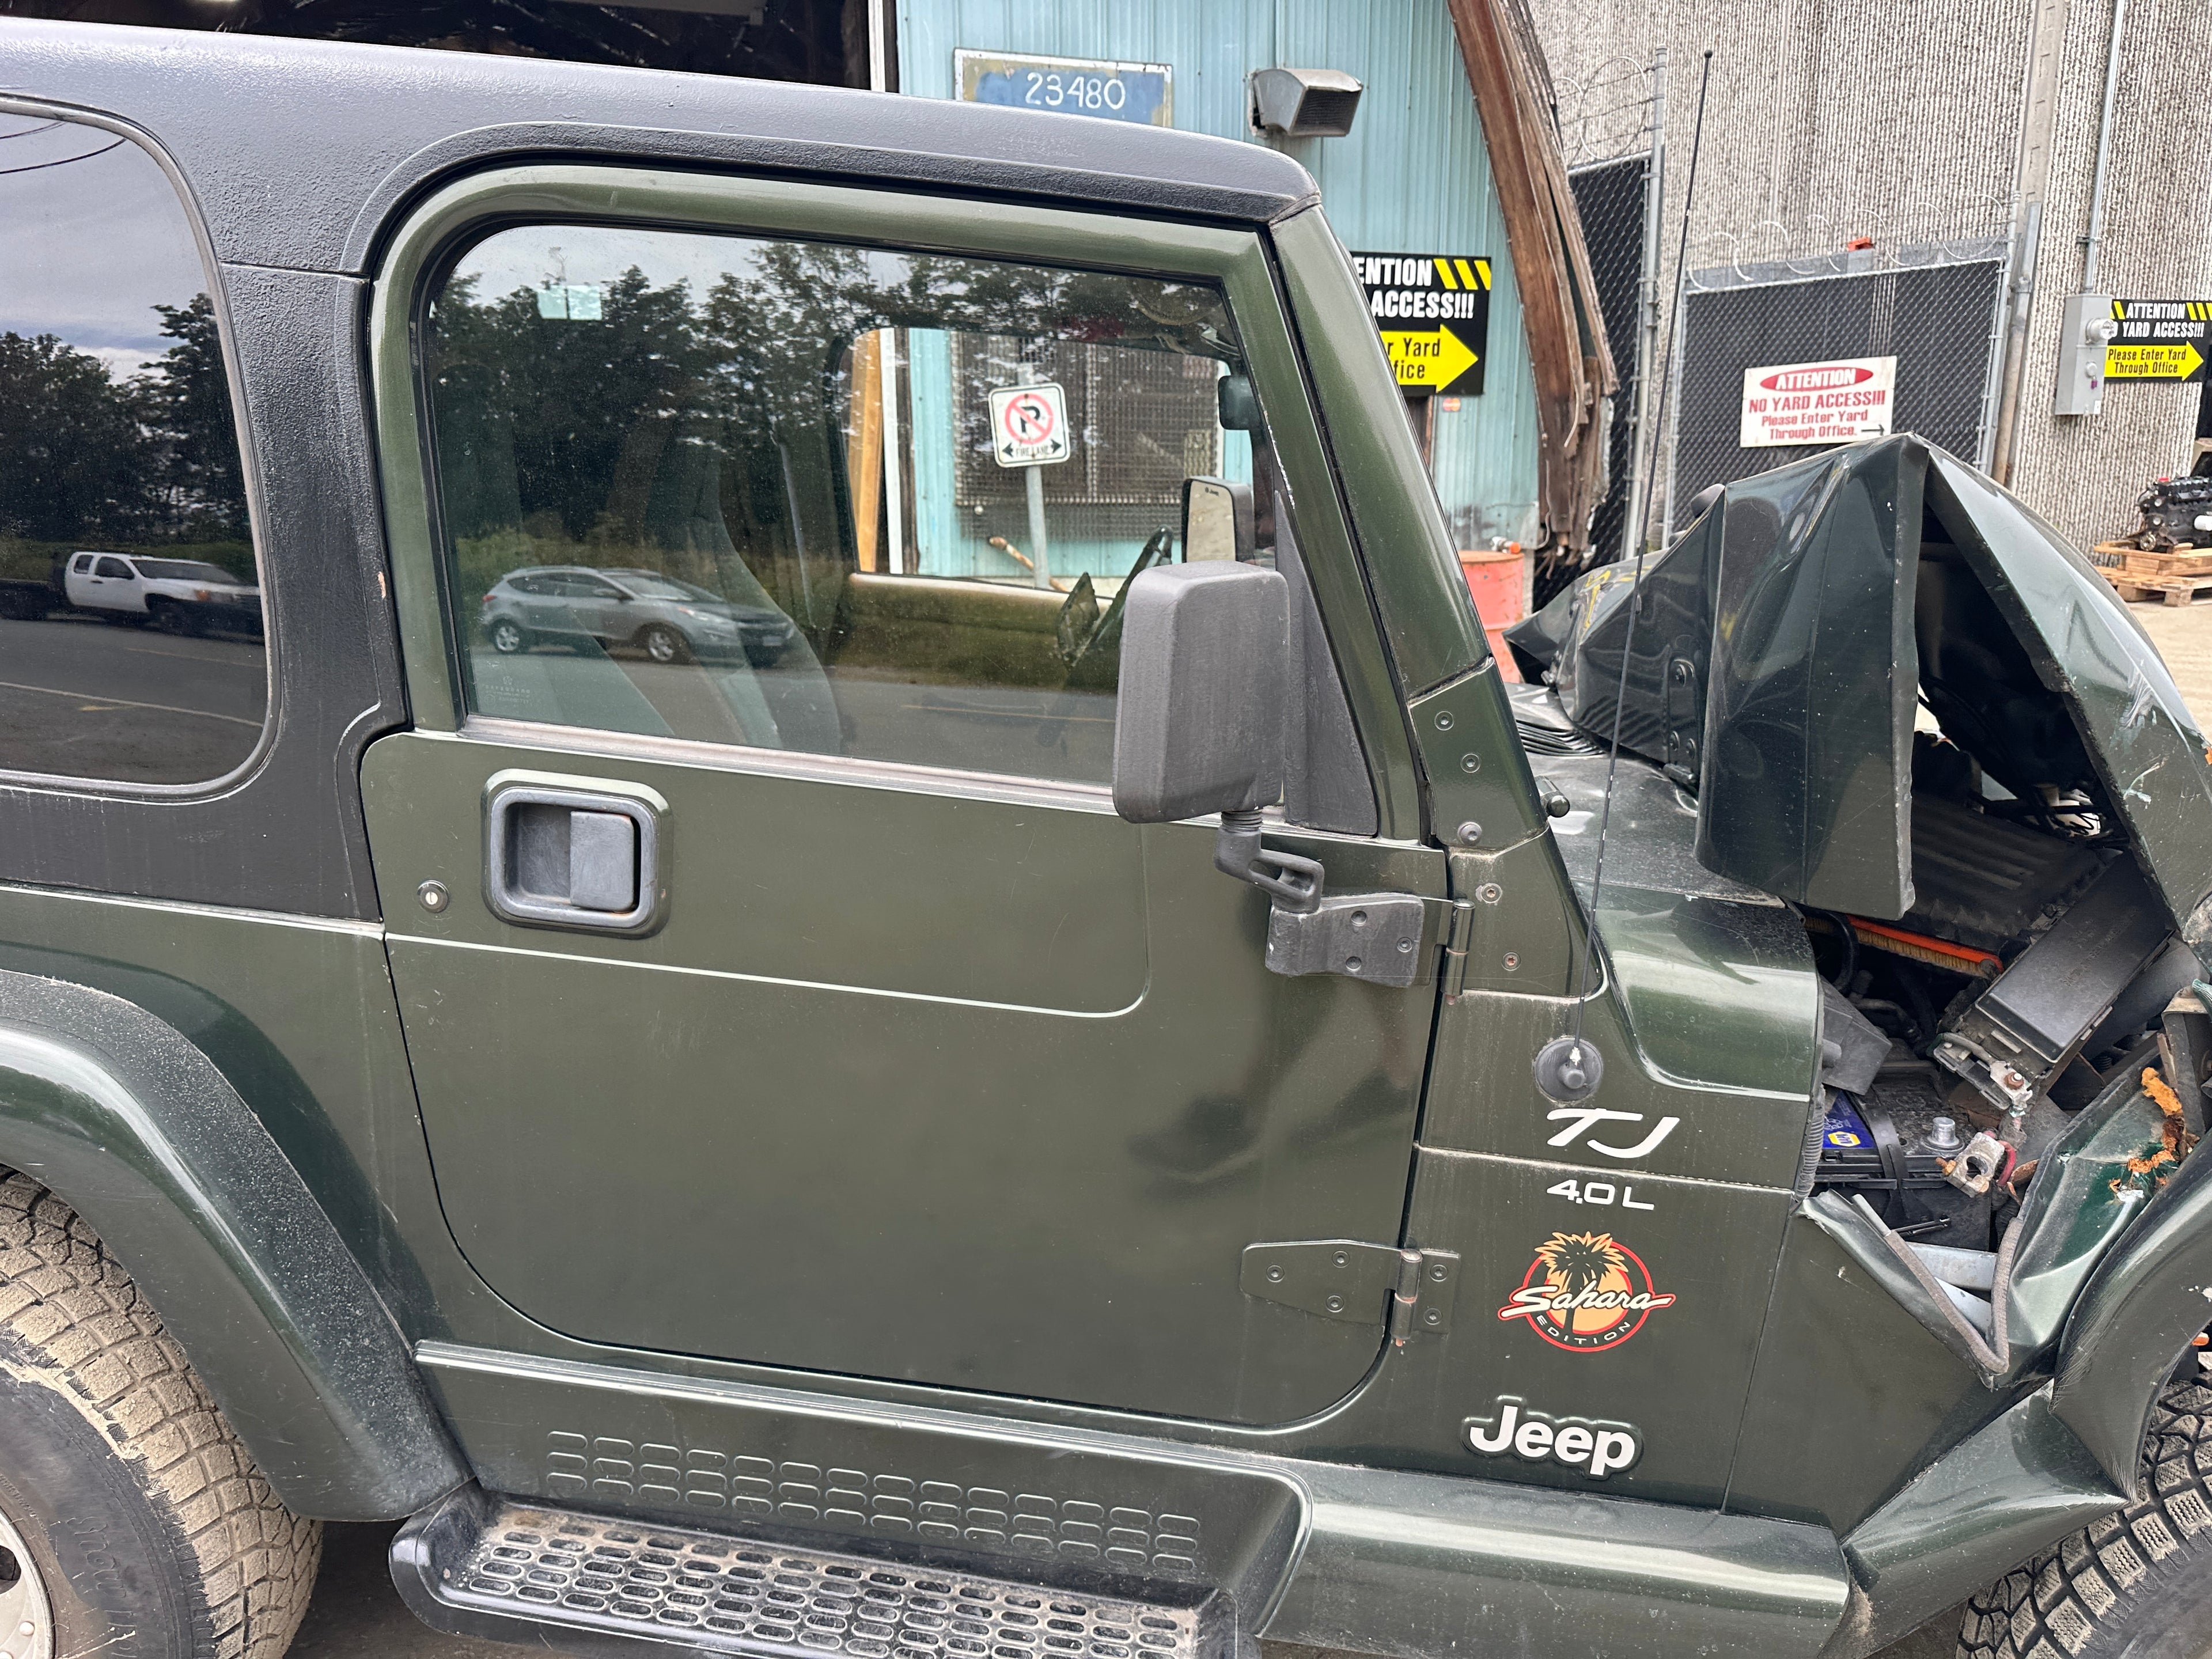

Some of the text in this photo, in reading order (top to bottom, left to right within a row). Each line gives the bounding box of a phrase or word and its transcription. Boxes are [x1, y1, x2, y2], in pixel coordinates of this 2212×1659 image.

[1025, 73, 1126, 109] 23480
[1370, 290, 1474, 319] ACCESS!!!
[2126, 303, 2186, 319] ATTENTION
[2123, 322, 2150, 338] YARD
[2153, 322, 2205, 338] ACCESS!!!
[1403, 338, 1441, 357] Yard
[2108, 349, 2187, 361] Please Enter Yard
[2115, 362, 2178, 375] Through Office
[1775, 369, 1856, 390] ATTENTION
[1749, 399, 1767, 413] NO
[1772, 396, 1810, 412] YARD
[1762, 409, 1868, 427] Please Enter Yard
[1770, 428, 1815, 440] Through
[1547, 1108, 1680, 1159] TJ
[1500, 1279, 1672, 1318] Sahara
[1536, 1315, 1631, 1344] EDITION
[1469, 1405, 1635, 1476] Jeep
